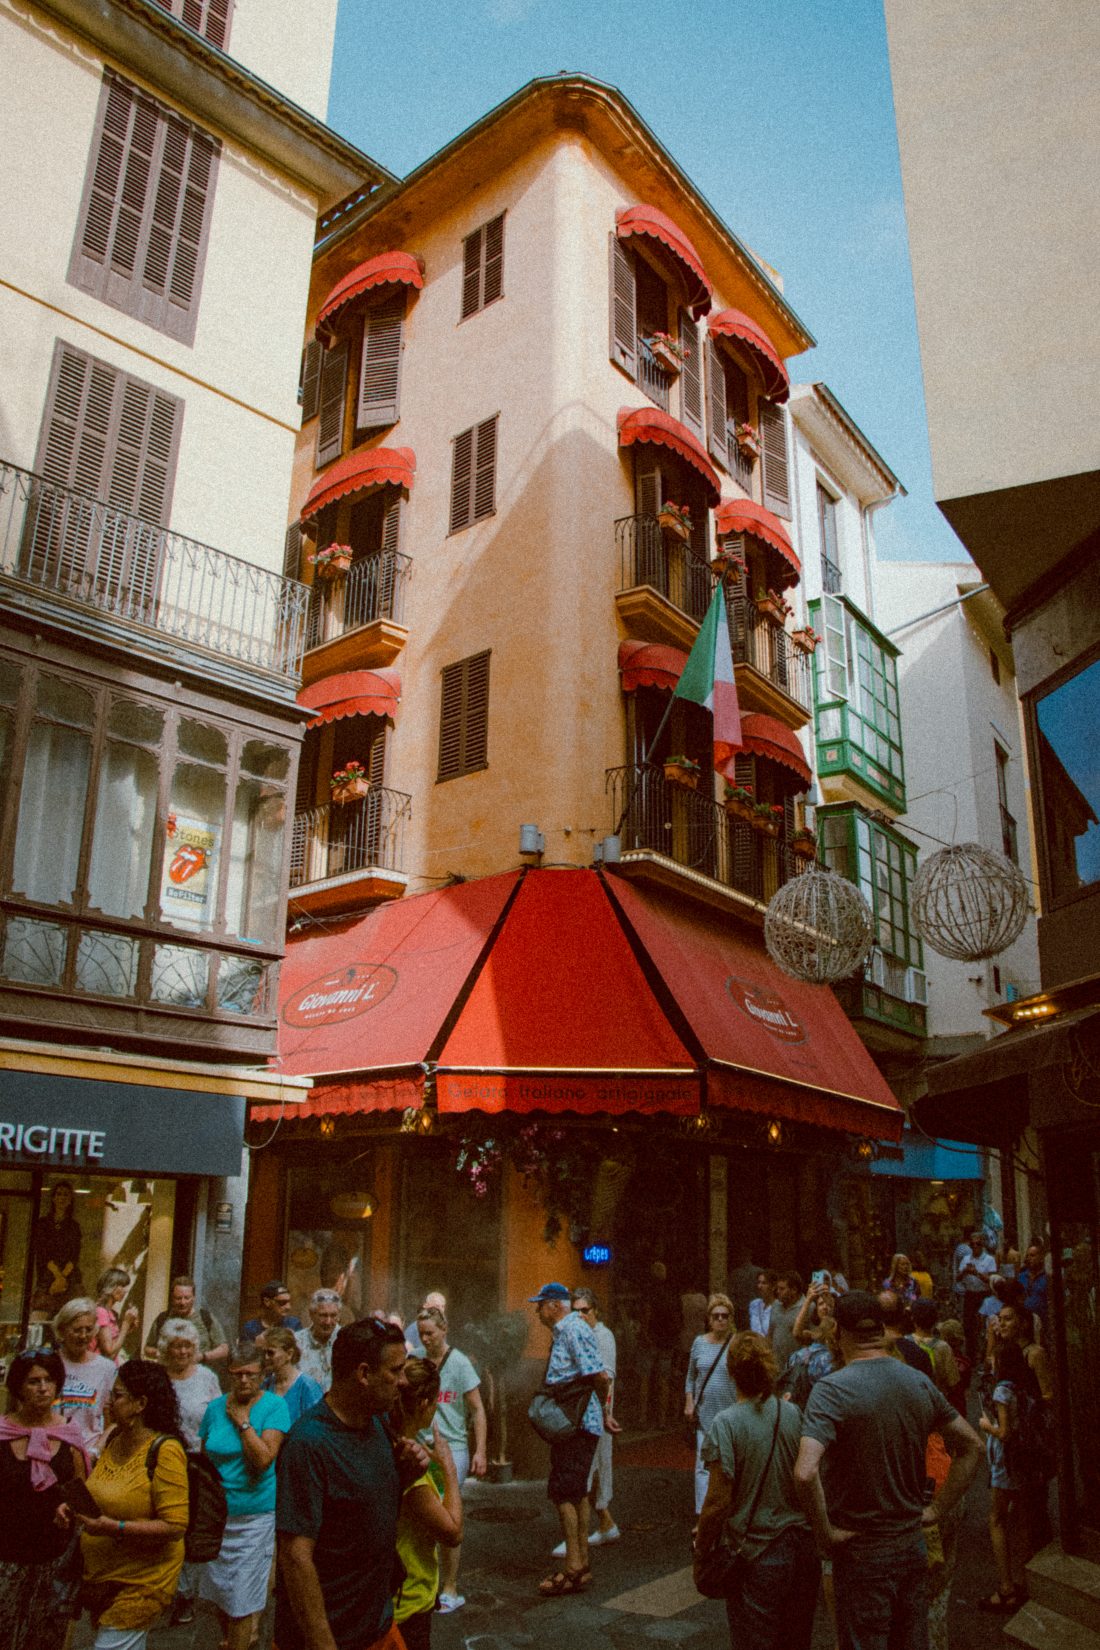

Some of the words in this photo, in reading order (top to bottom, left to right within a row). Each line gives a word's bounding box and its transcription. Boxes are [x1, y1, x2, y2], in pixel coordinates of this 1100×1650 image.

[298, 984, 366, 1012] Giovanni
[519, 1083, 585, 1100] Italiano
[0, 1122, 106, 1158] RIGITTE
